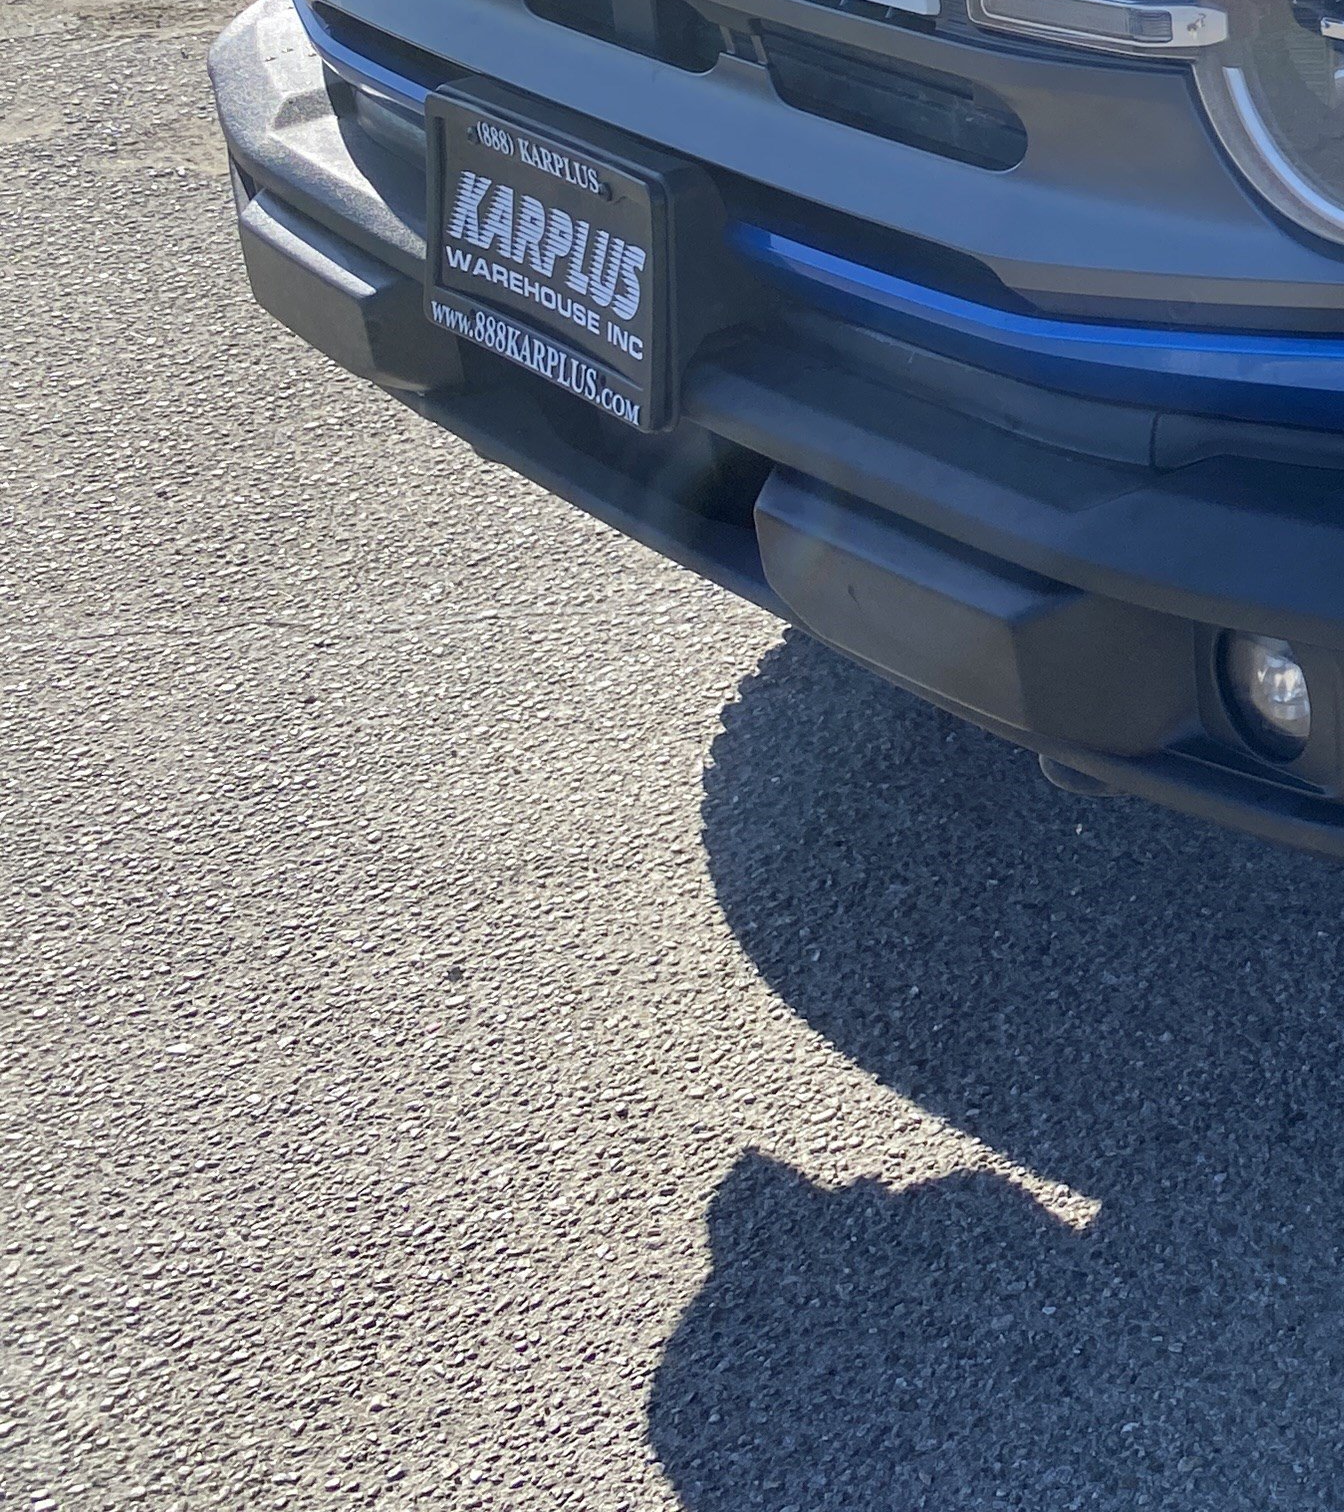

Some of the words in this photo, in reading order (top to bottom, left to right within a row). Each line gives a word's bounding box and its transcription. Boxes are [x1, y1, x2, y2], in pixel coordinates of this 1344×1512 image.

[476, 120, 515, 156] (888)
[517, 137, 600, 194] KARPLUS
[445, 245, 601, 335] WAREHOUSE
[607, 320, 644, 361] INC
[446, 169, 647, 321] KARPLUS
